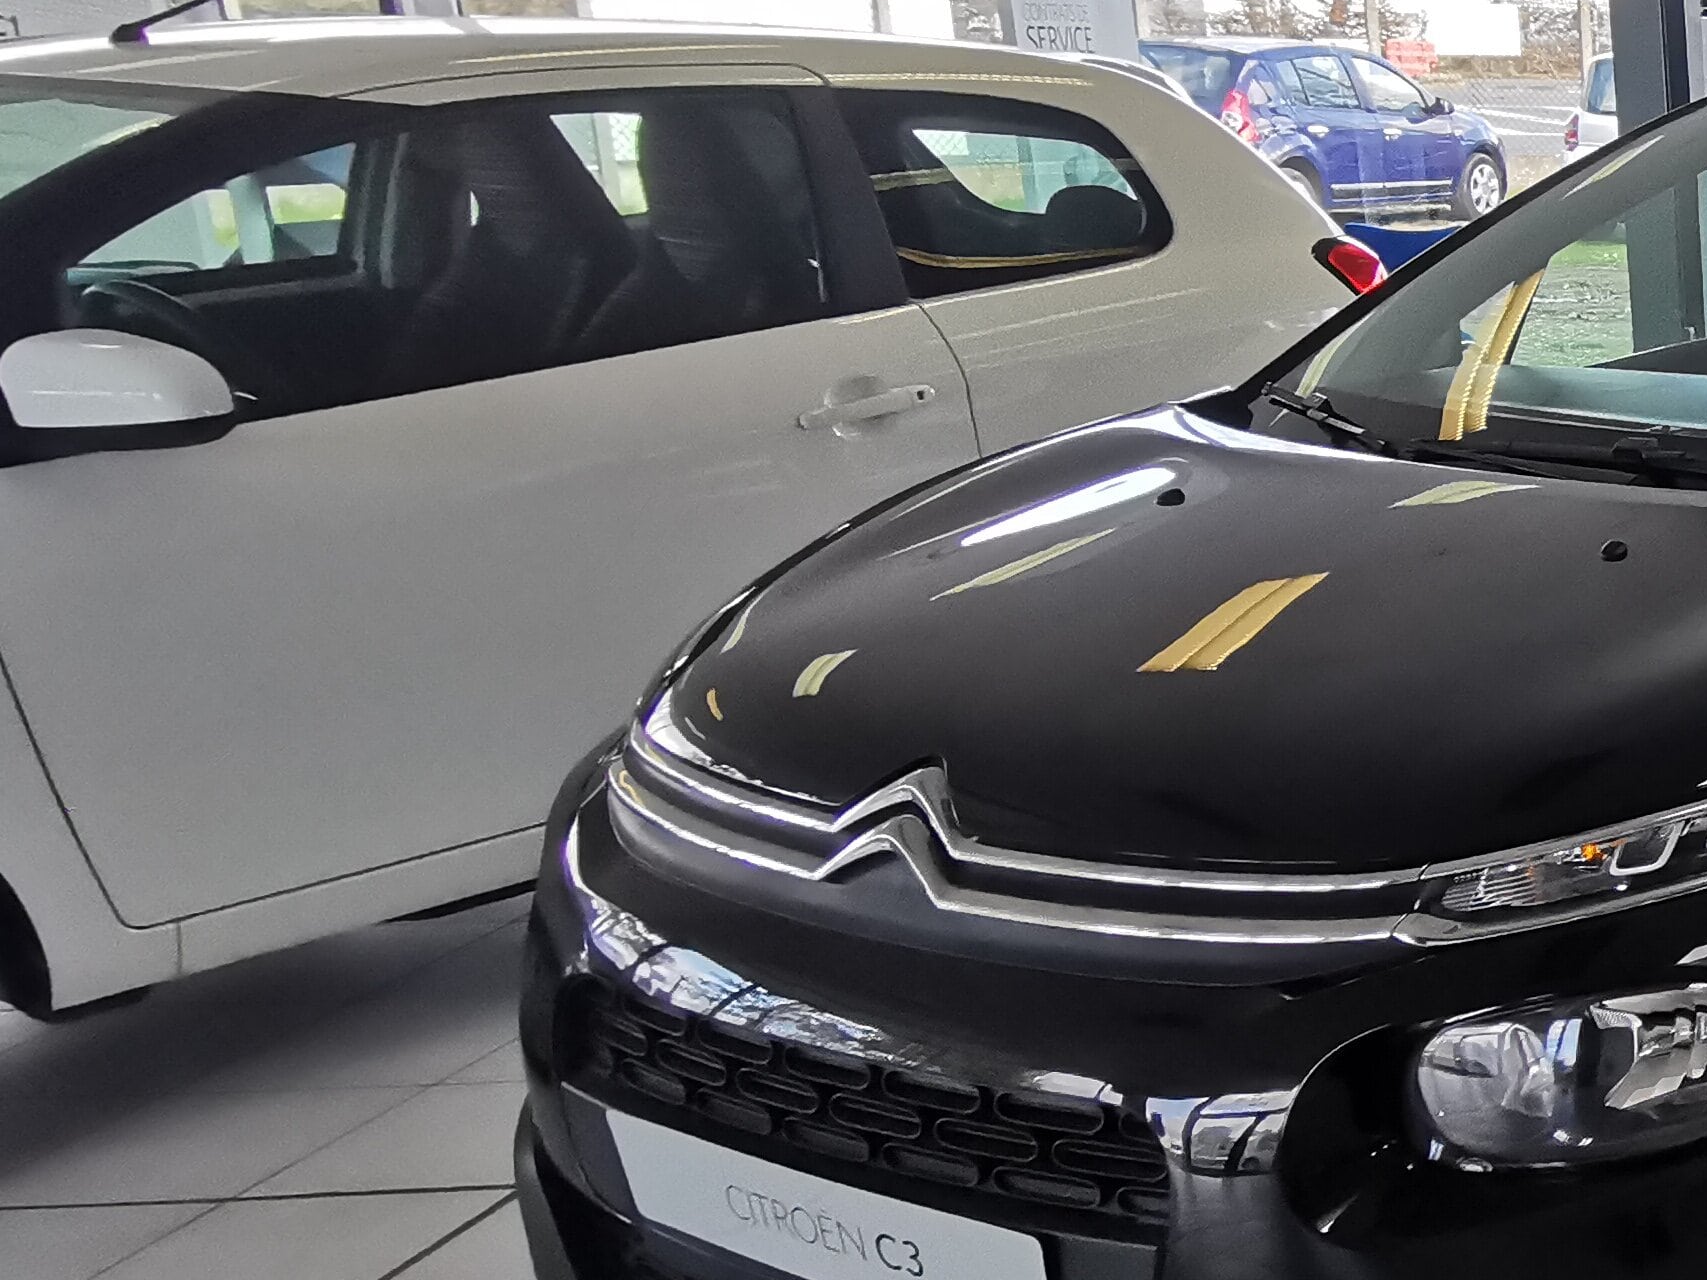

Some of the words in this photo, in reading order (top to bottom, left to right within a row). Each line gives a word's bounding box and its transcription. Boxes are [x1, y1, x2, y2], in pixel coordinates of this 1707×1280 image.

[1026, 24, 1096, 54] SERVICE
[726, 1184, 868, 1261] CITROËN
[874, 1233, 924, 1277] C3
